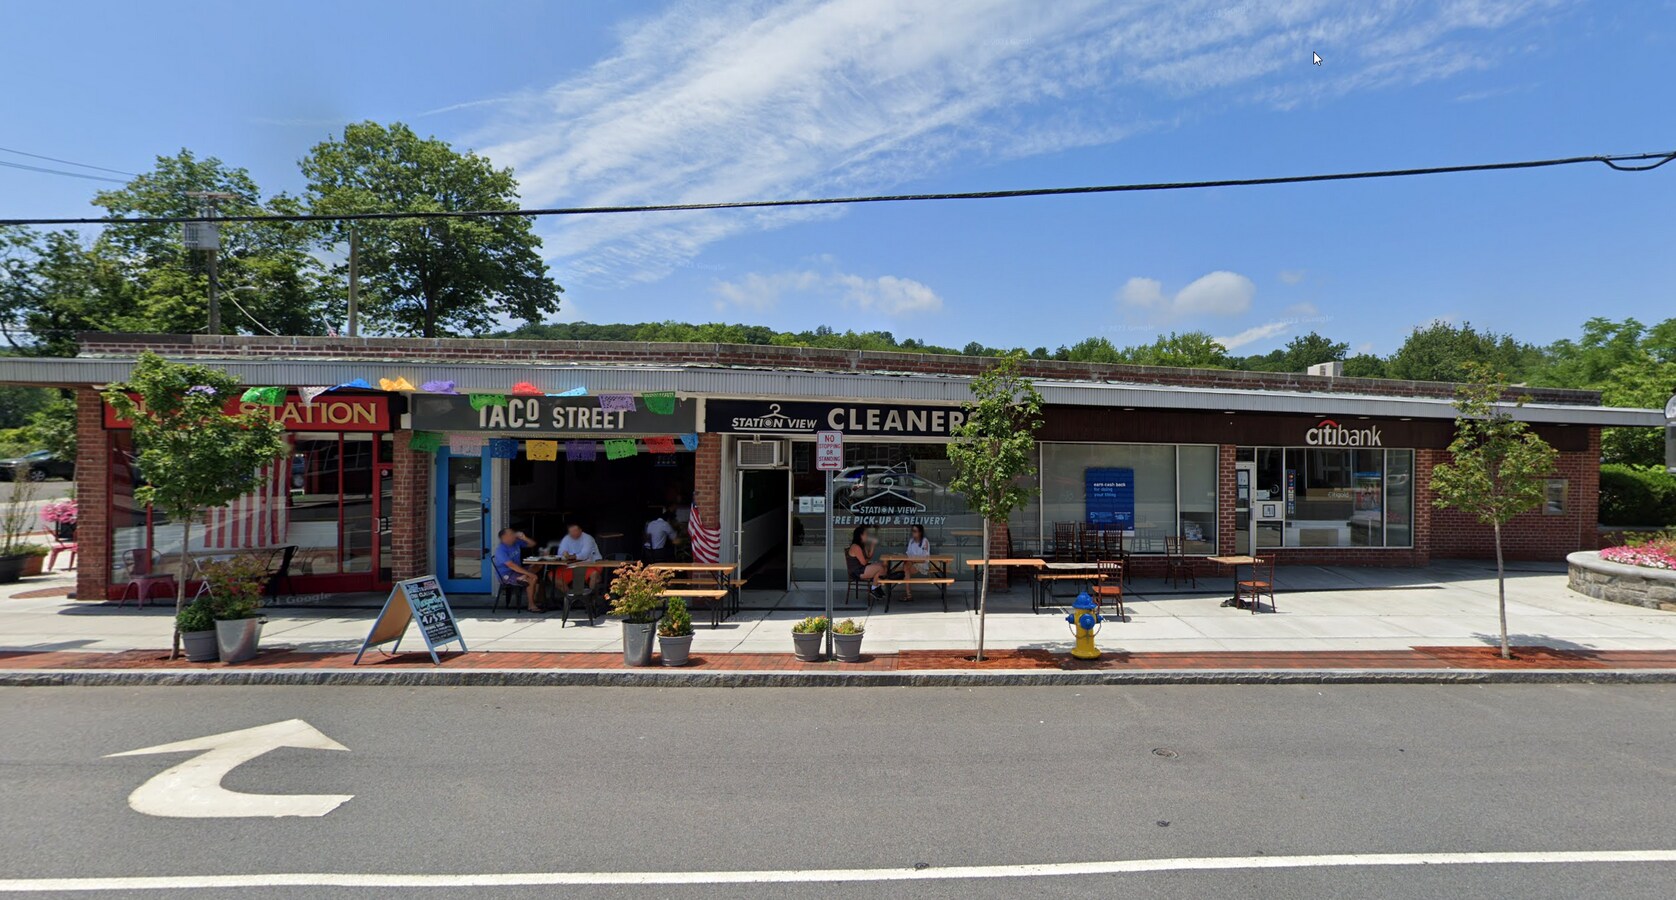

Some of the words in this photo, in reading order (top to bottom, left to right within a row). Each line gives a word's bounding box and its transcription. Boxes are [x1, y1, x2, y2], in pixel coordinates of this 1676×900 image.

[480, 399, 539, 428] TACO
[552, 407, 625, 429] STREET
[732, 418, 783, 428] STATION
[788, 419, 817, 429] VIEW
[1305, 421, 1382, 446] citibank
[824, 435, 835, 443] NO
[860, 506, 894, 514] STATION
[897, 506, 917, 514] VIEW
[853, 516, 891, 525] PICK-UP
[894, 516, 900, 525] &
[903, 516, 946, 525] DELIVERY
